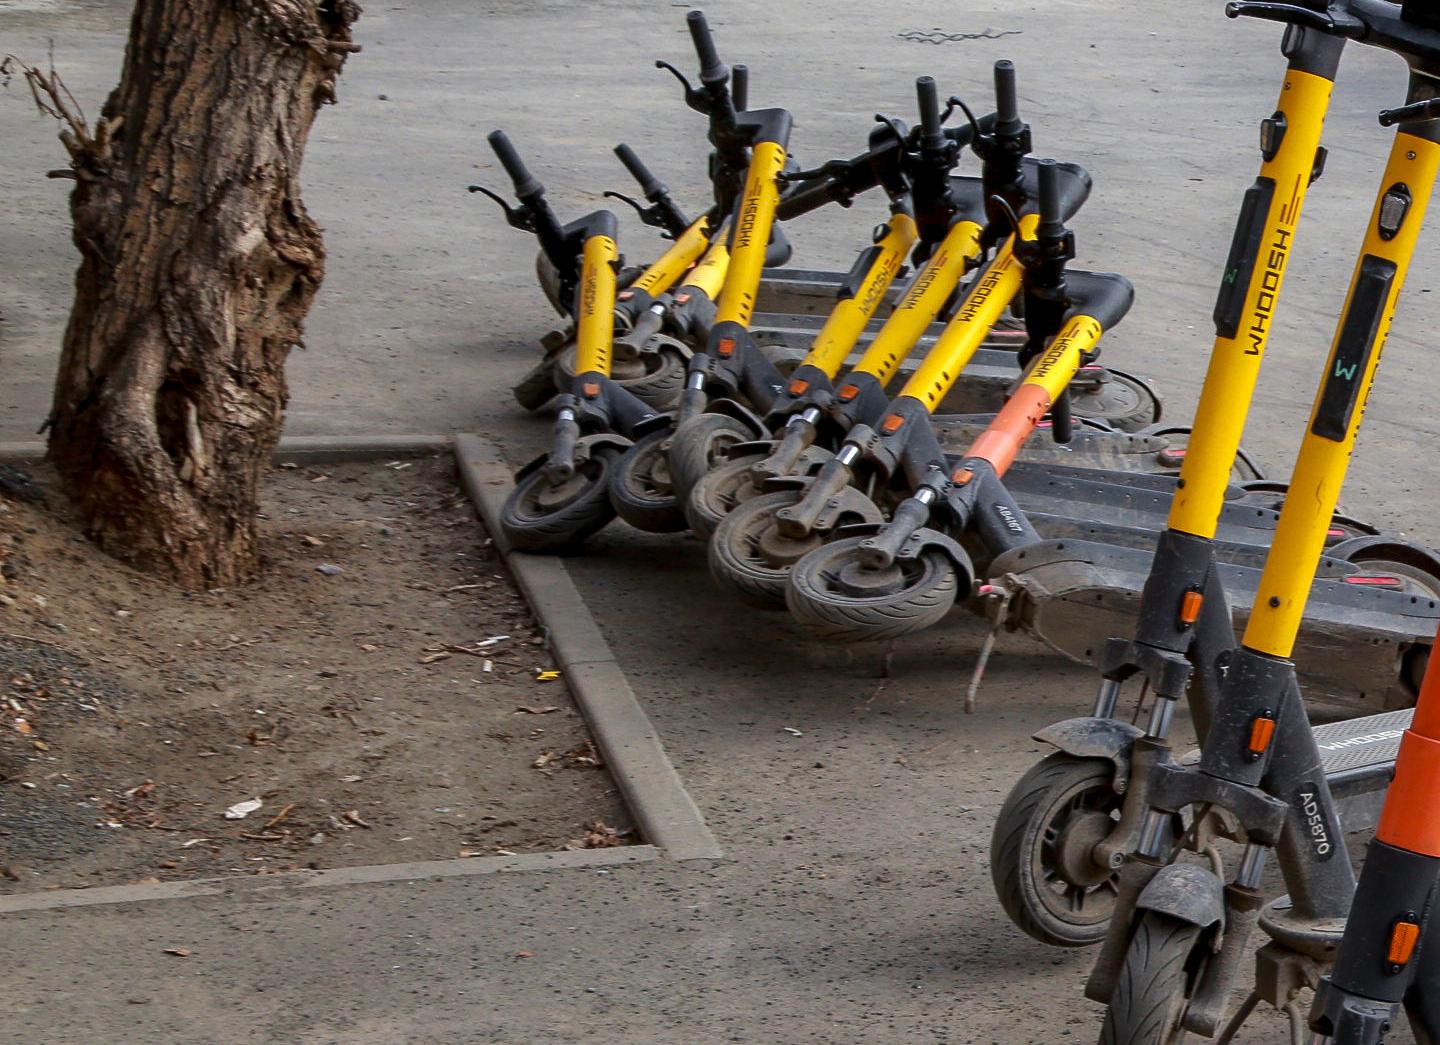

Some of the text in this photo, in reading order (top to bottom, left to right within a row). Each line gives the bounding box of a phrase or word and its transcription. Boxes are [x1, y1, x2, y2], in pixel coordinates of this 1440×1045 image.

[736, 197, 760, 249] WHOOSH
[900, 267, 941, 310] WHOOSH
[957, 271, 1004, 322] WHOOSH
[1244, 228, 1291, 356] WHOOSH
[1031, 337, 1073, 378] WHOOSH
[1334, 359, 1358, 380] W
[1317, 728, 1404, 750] WHOOS
[1300, 793, 1330, 854] AD5870
